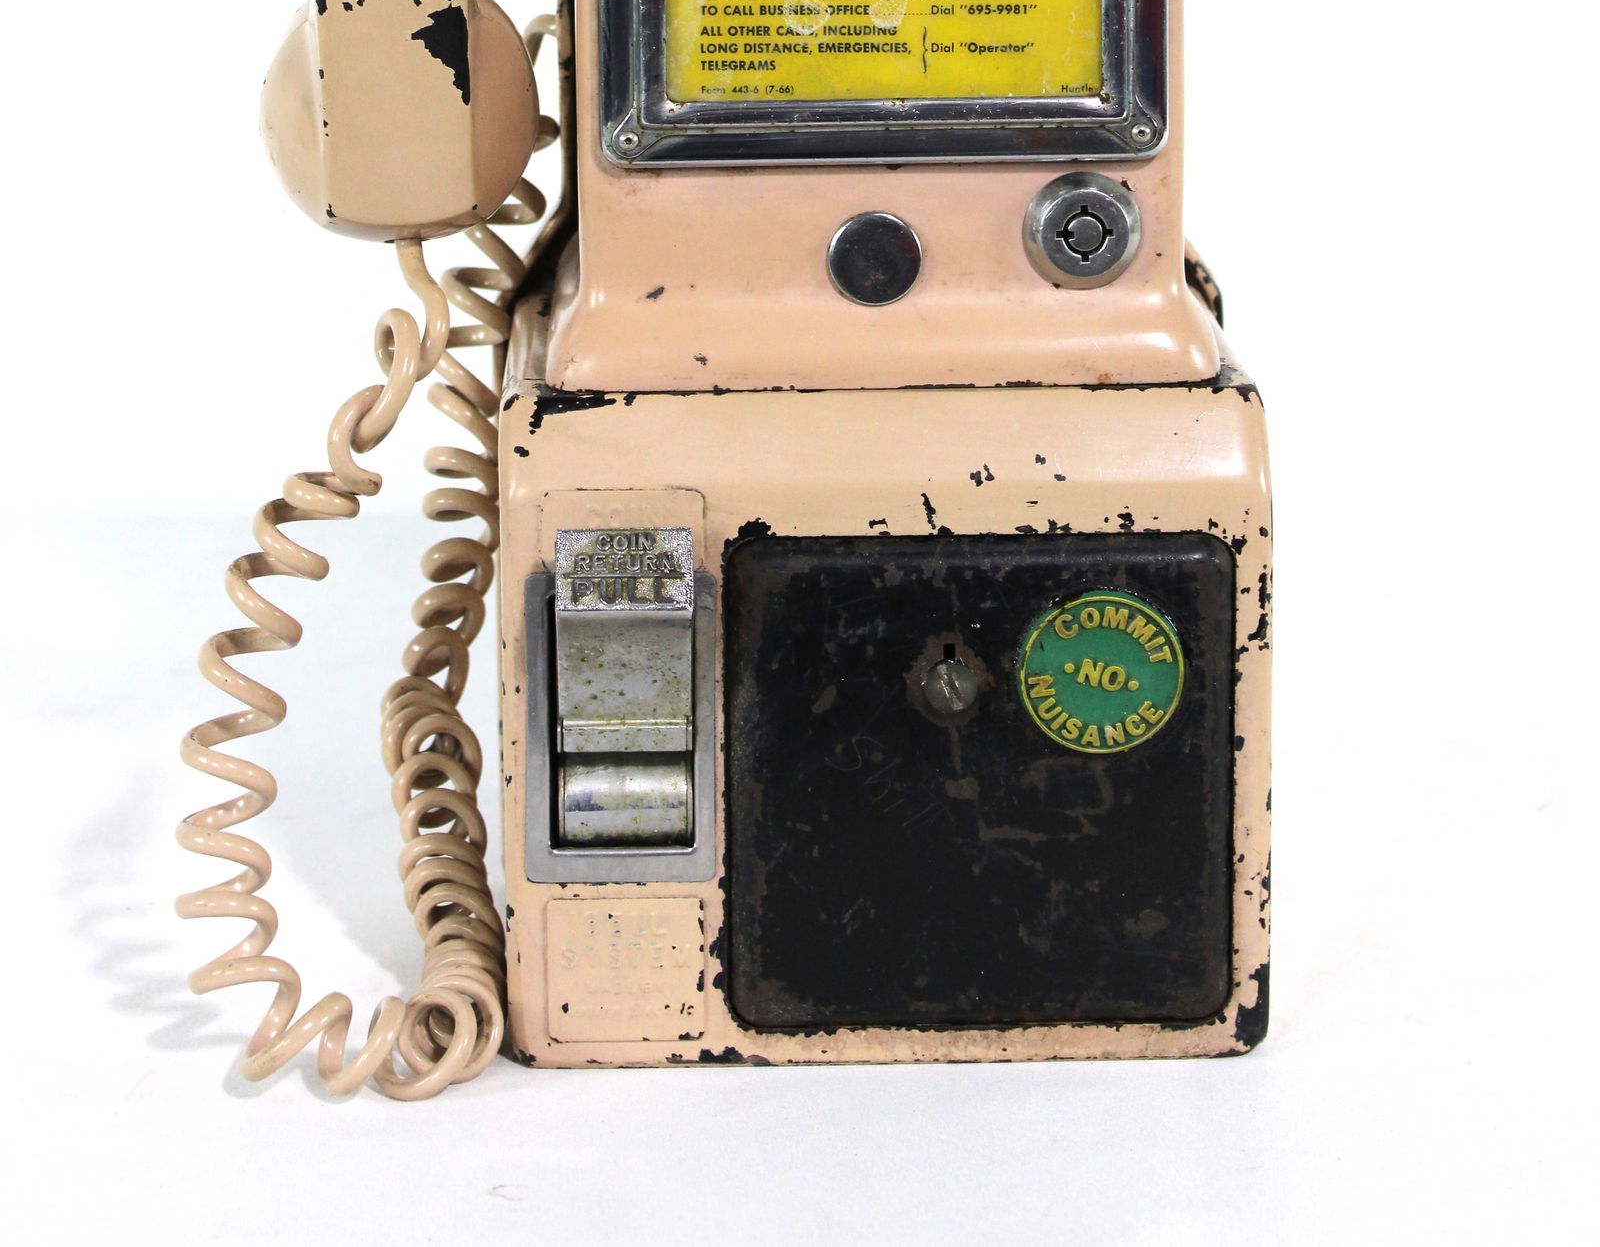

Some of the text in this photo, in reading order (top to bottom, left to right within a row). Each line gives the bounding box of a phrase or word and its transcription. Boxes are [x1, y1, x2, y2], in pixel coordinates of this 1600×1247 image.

[701, 5, 719, 17] TO
[723, 5, 755, 17] CALL
[825, 4, 871, 16] OFFICE
[930, 3, 1037, 16] Dial "695-9981"
[700, 25, 898, 38] ALL OTHER CALS, INCLUDING
[700, 41, 912, 56] LONG DISTANCE, EMERGENCIES,
[930, 41, 955, 53] Dial
[700, 59, 777, 72] TELEGRAMS
[731, 85, 760, 95] 443-6
[765, 84, 795, 96] (7-66)
[1061, 83, 1098, 94] Huntle
[595, 532, 655, 552] COIN
[574, 554, 675, 572] RETURN
[571, 577, 680, 605] PULL
[1054, 606, 1173, 664] COMMIT
[1027, 674, 1164, 747] NUISANCE
